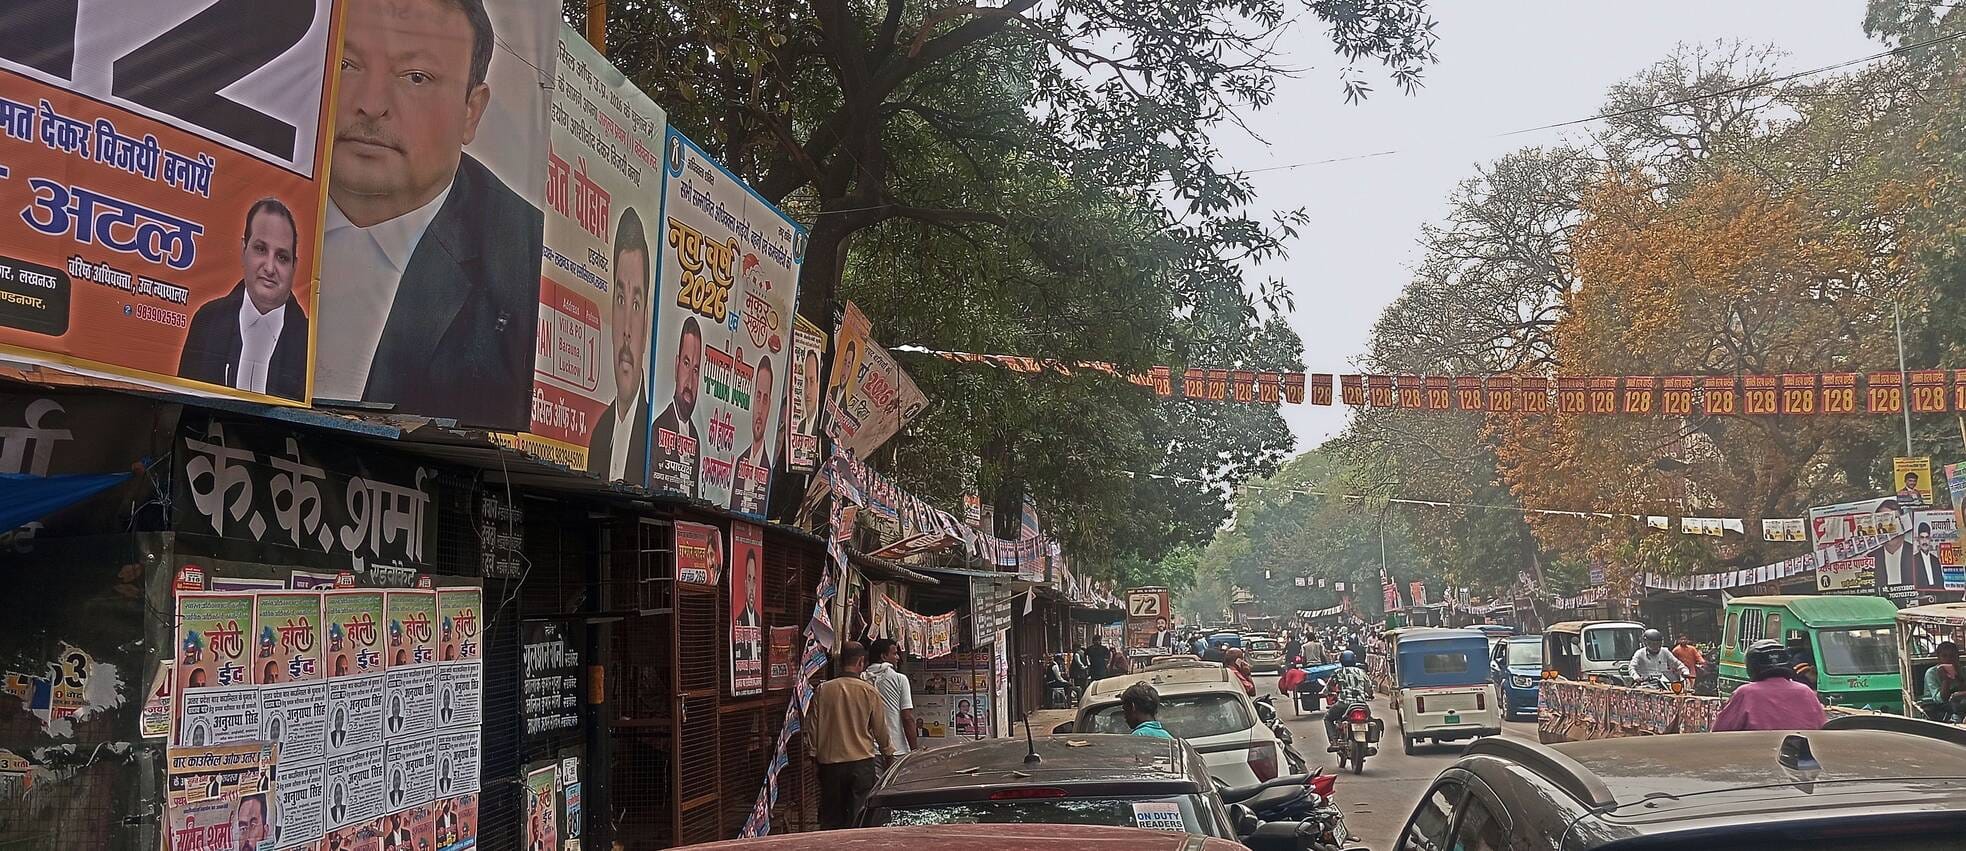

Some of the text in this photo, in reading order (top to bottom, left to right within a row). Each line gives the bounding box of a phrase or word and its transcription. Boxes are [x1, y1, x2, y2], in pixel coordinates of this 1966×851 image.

[40, 99, 91, 160] देकर
[95, 117, 160, 181] विजयी
[163, 150, 215, 198] बनायें
[574, 155, 612, 244] चौहान
[20, 178, 204, 269] अटल
[667, 216, 740, 290] नव वर्ष
[19, 269, 57, 290] लखनऊ
[677, 270, 728, 324] 2026
[745, 291, 772, 318] मकर
[569, 322, 575, 336] &
[588, 336, 596, 382] 1
[1153, 378, 1170, 396] 128
[1185, 380, 1203, 398] 128
[1207, 380, 1225, 399] 128
[1234, 382, 1251, 401] 128
[1260, 382, 1279, 402] 128
[1286, 383, 1304, 402] 128
[1312, 384, 1332, 404] 128
[1343, 385, 1363, 404] 128
[1370, 386, 1392, 406] 128
[1400, 387, 1421, 408] 128
[1428, 388, 1449, 409] 128
[1459, 389, 1481, 409] 128
[1489, 391, 1512, 411] 128
[1522, 391, 1547, 412] 128
[1560, 391, 1585, 412] 128
[1590, 391, 1614, 413] 128
[1625, 391, 1650, 412] 128
[1664, 391, 1690, 413] 128
[1704, 391, 1733, 413] 128
[1746, 390, 1776, 413] 128
[1784, 389, 1813, 413] 128
[1823, 388, 1853, 412] 128
[1870, 388, 1900, 412] 128
[1913, 387, 1945, 412] 128
[370, 560, 417, 587] एडवोकेट
[1133, 596, 1157, 614] 72
[343, 613, 376, 649] होली
[402, 611, 432, 645] होली
[453, 608, 476, 640] होली
[204, 619, 244, 662] होली
[277, 616, 314, 655] होली
[213, 710, 259, 731] अनुराधा सिंह
[286, 702, 326, 723] अनुराधा सिंह
[173, 756, 185, 769] बार
[188, 753, 221, 768] काउंसिल
[1137, 812, 1179, 820] ON DUTY
[1139, 820, 1183, 828] READERS
